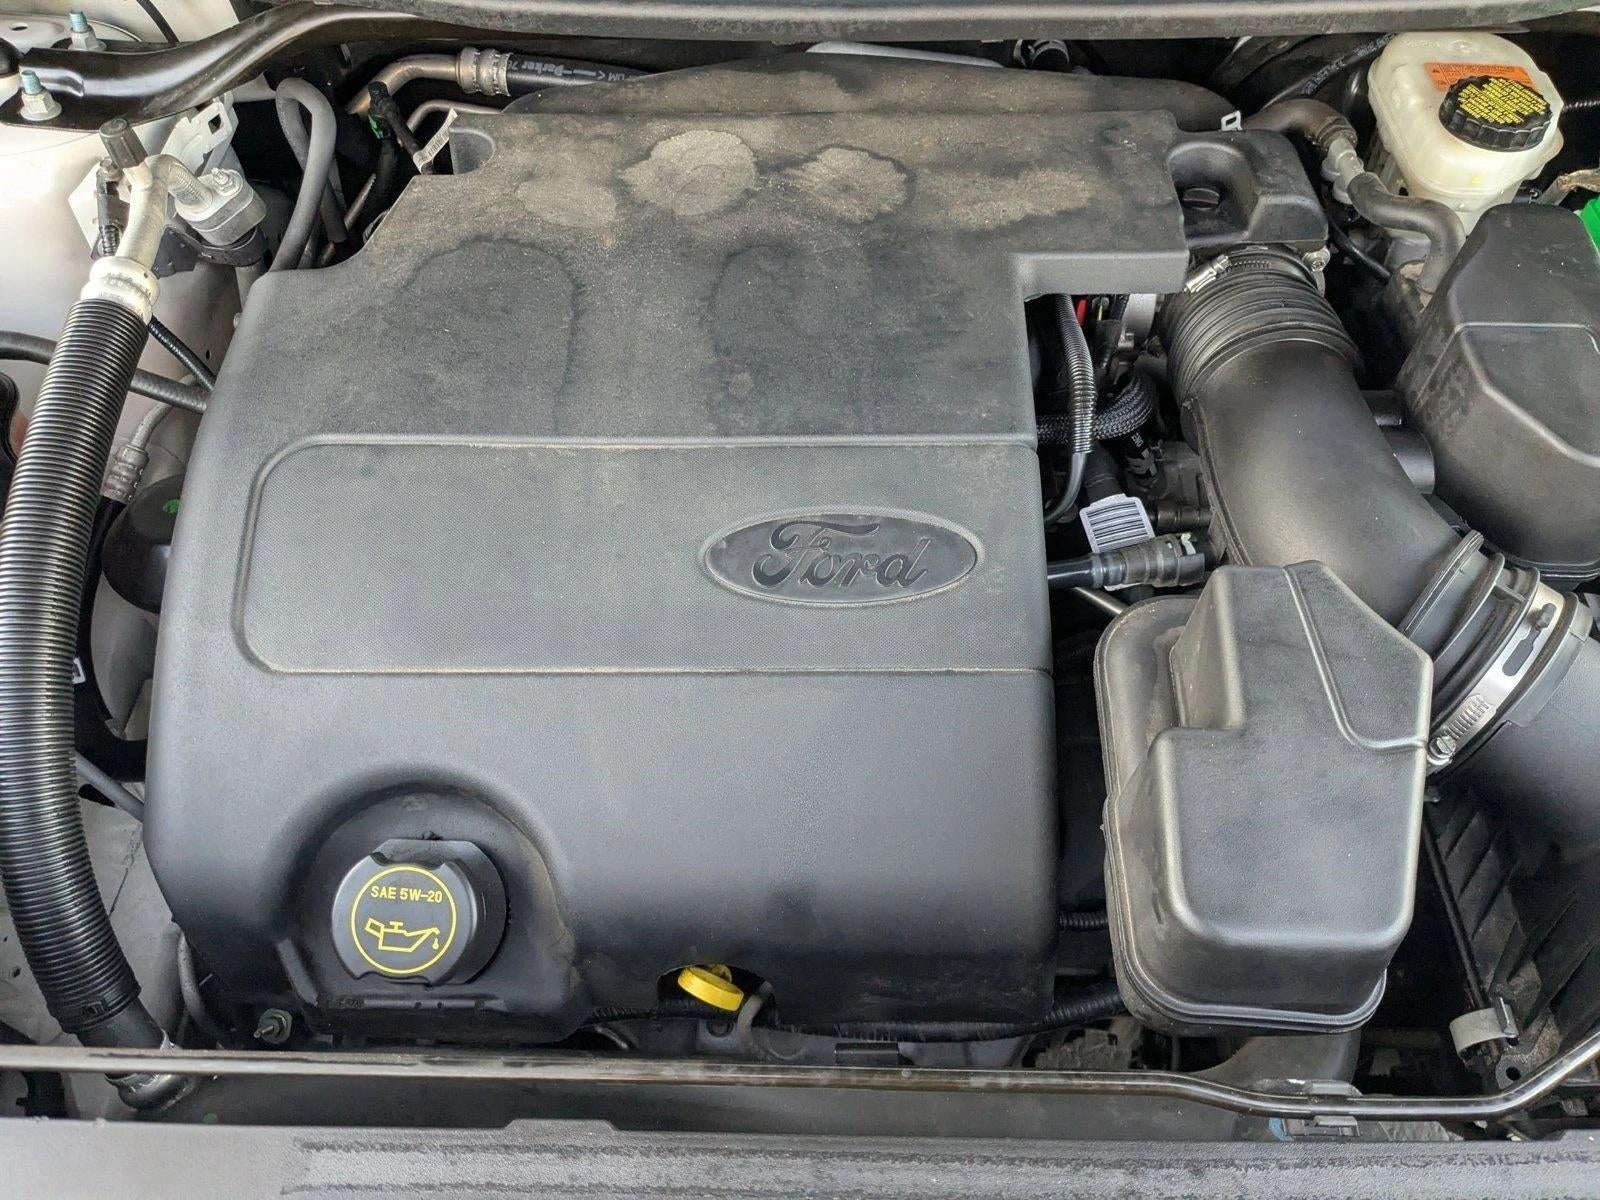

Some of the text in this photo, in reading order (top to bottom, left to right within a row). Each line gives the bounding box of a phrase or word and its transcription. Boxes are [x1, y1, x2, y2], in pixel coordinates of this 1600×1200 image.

[521, 61, 564, 76] Parker
[752, 520, 932, 589] Ford
[370, 885, 443, 903] SAE 5W-20
